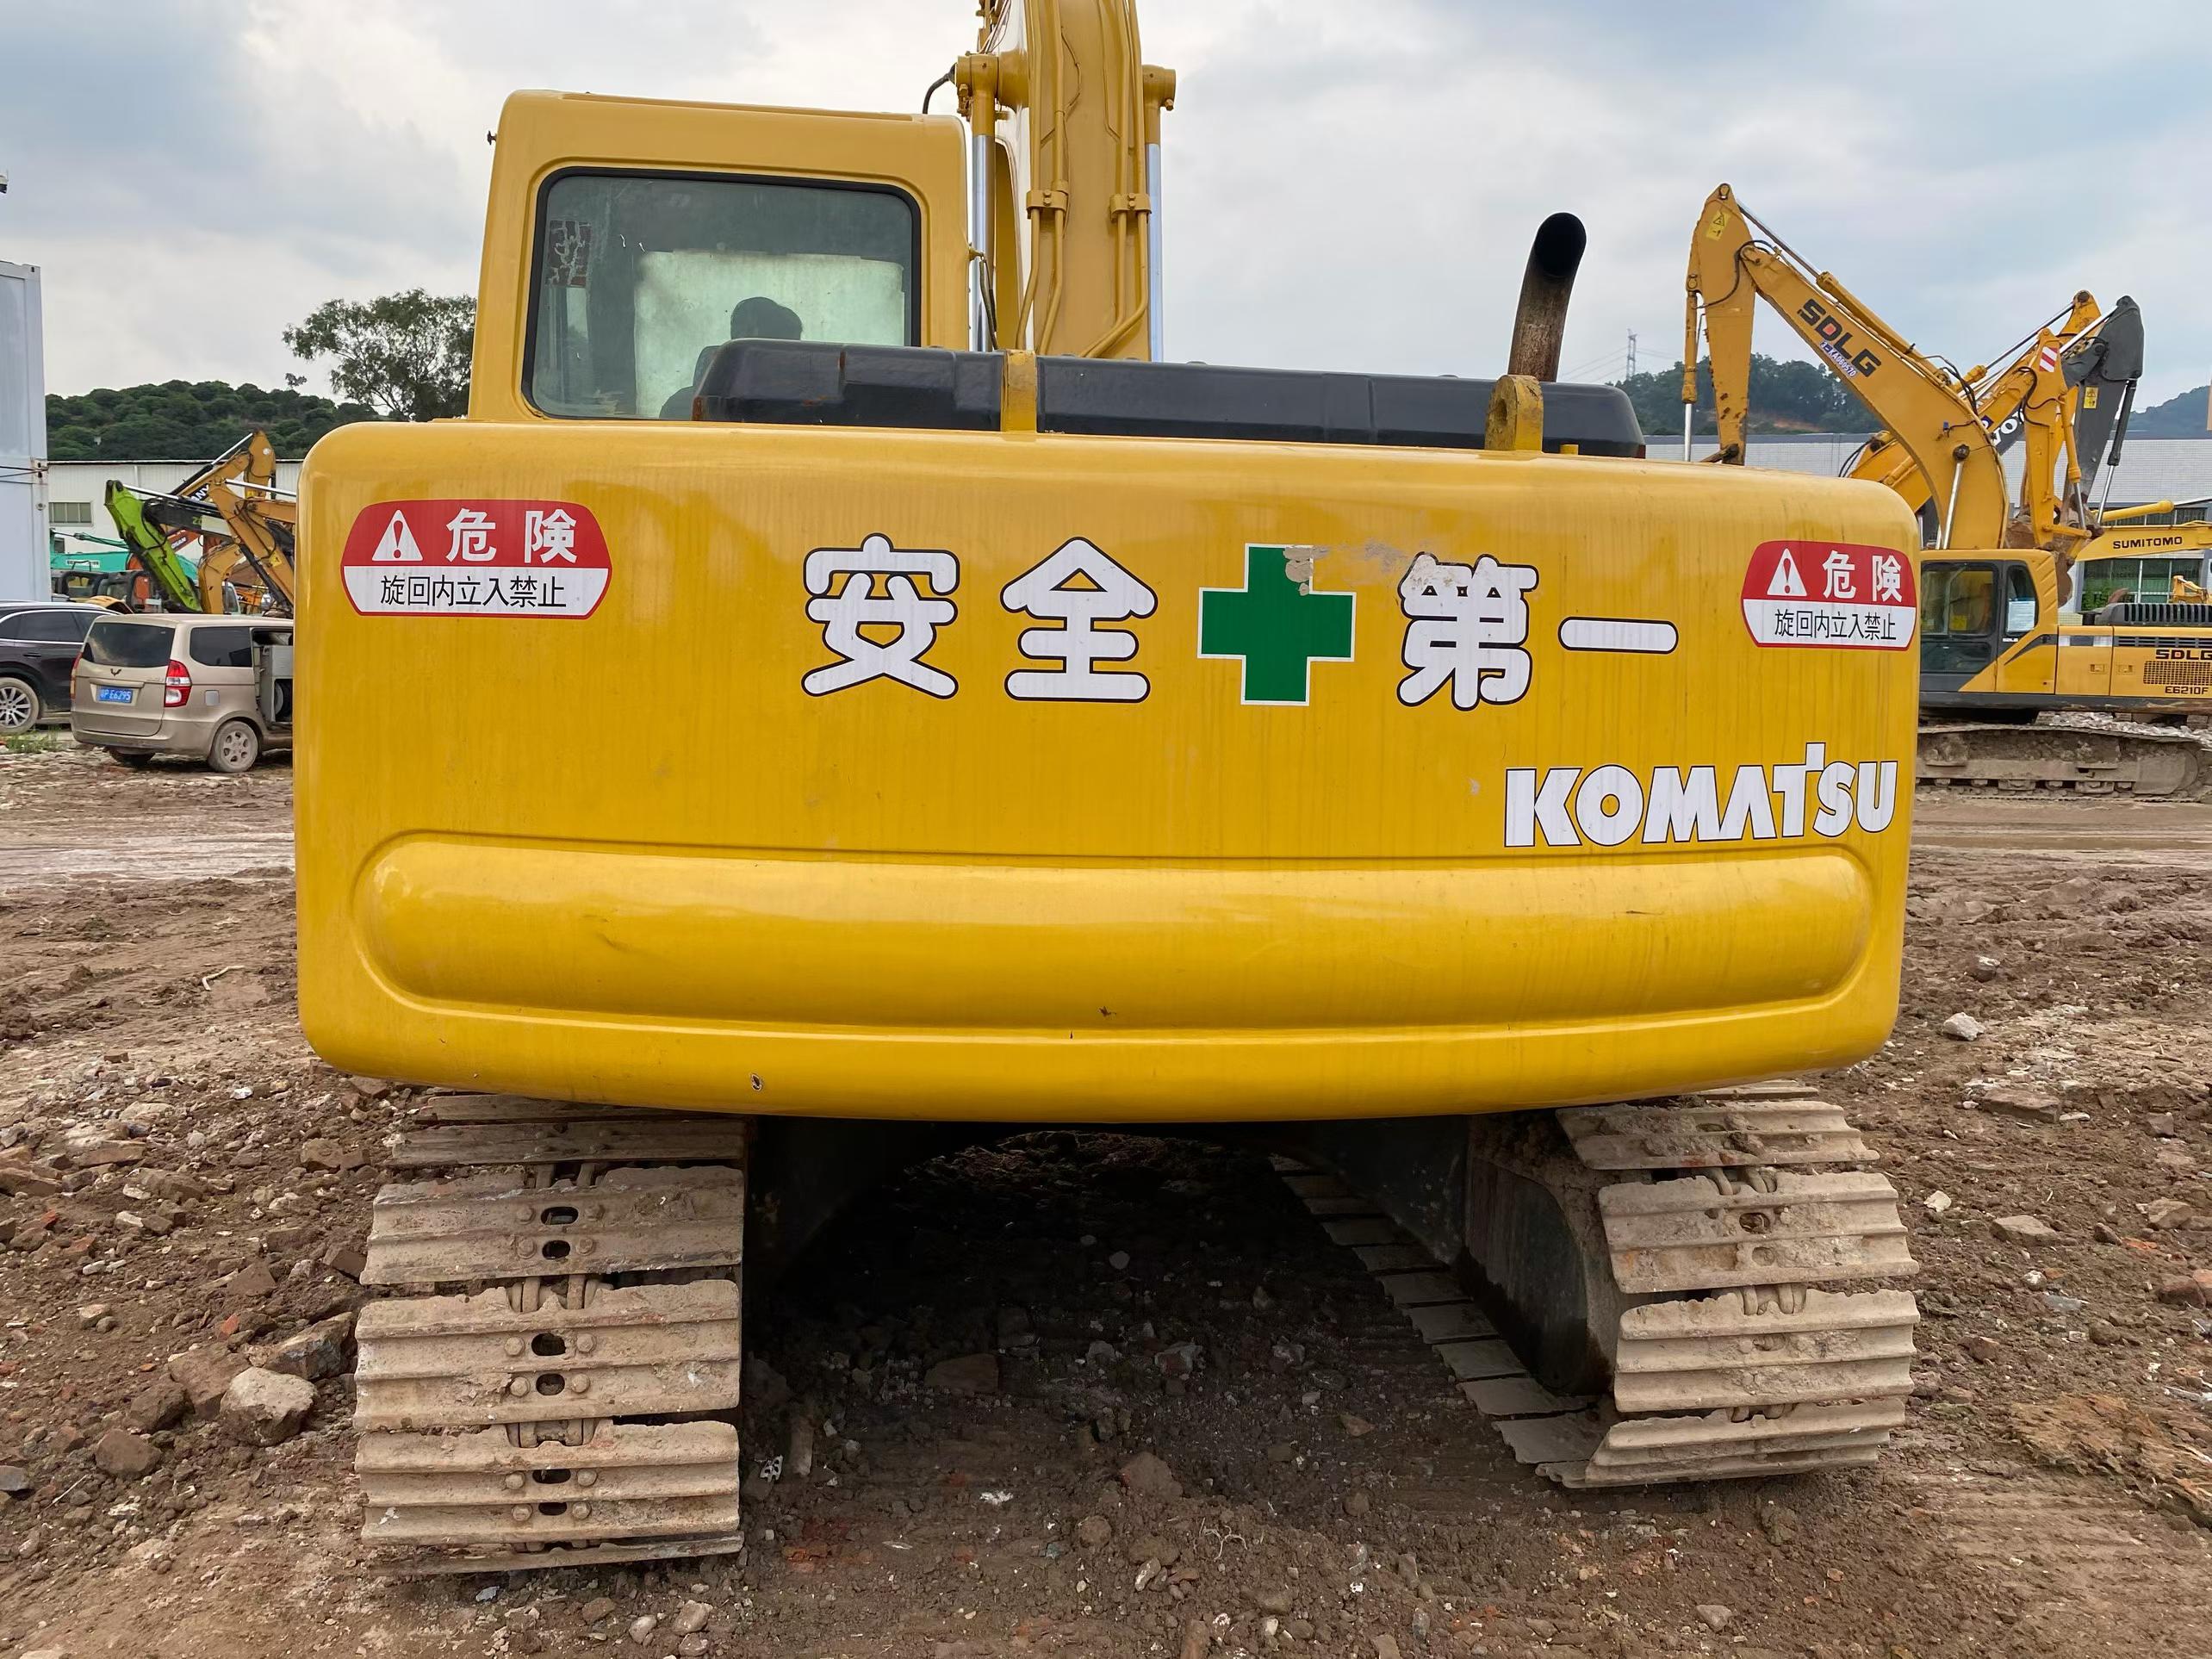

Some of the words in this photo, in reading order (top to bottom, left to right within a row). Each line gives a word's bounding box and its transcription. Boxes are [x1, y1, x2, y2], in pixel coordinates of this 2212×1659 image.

[1797, 299, 1881, 376] SDLG
[445, 508, 577, 563] 危険
[2113, 537, 2183, 549] SUMITOMO
[380, 575, 567, 608] 旋回内立入禁止
[1822, 550, 1902, 603] 危険
[802, 533, 1159, 702] 安全
[1395, 552, 1679, 711] 第一
[1774, 608, 1897, 641] 旋回内立入禁止
[2155, 649, 2212, 661] SDLG
[2165, 686, 2209, 695] E6210F
[1504, 742, 1898, 847] KOMATSU
